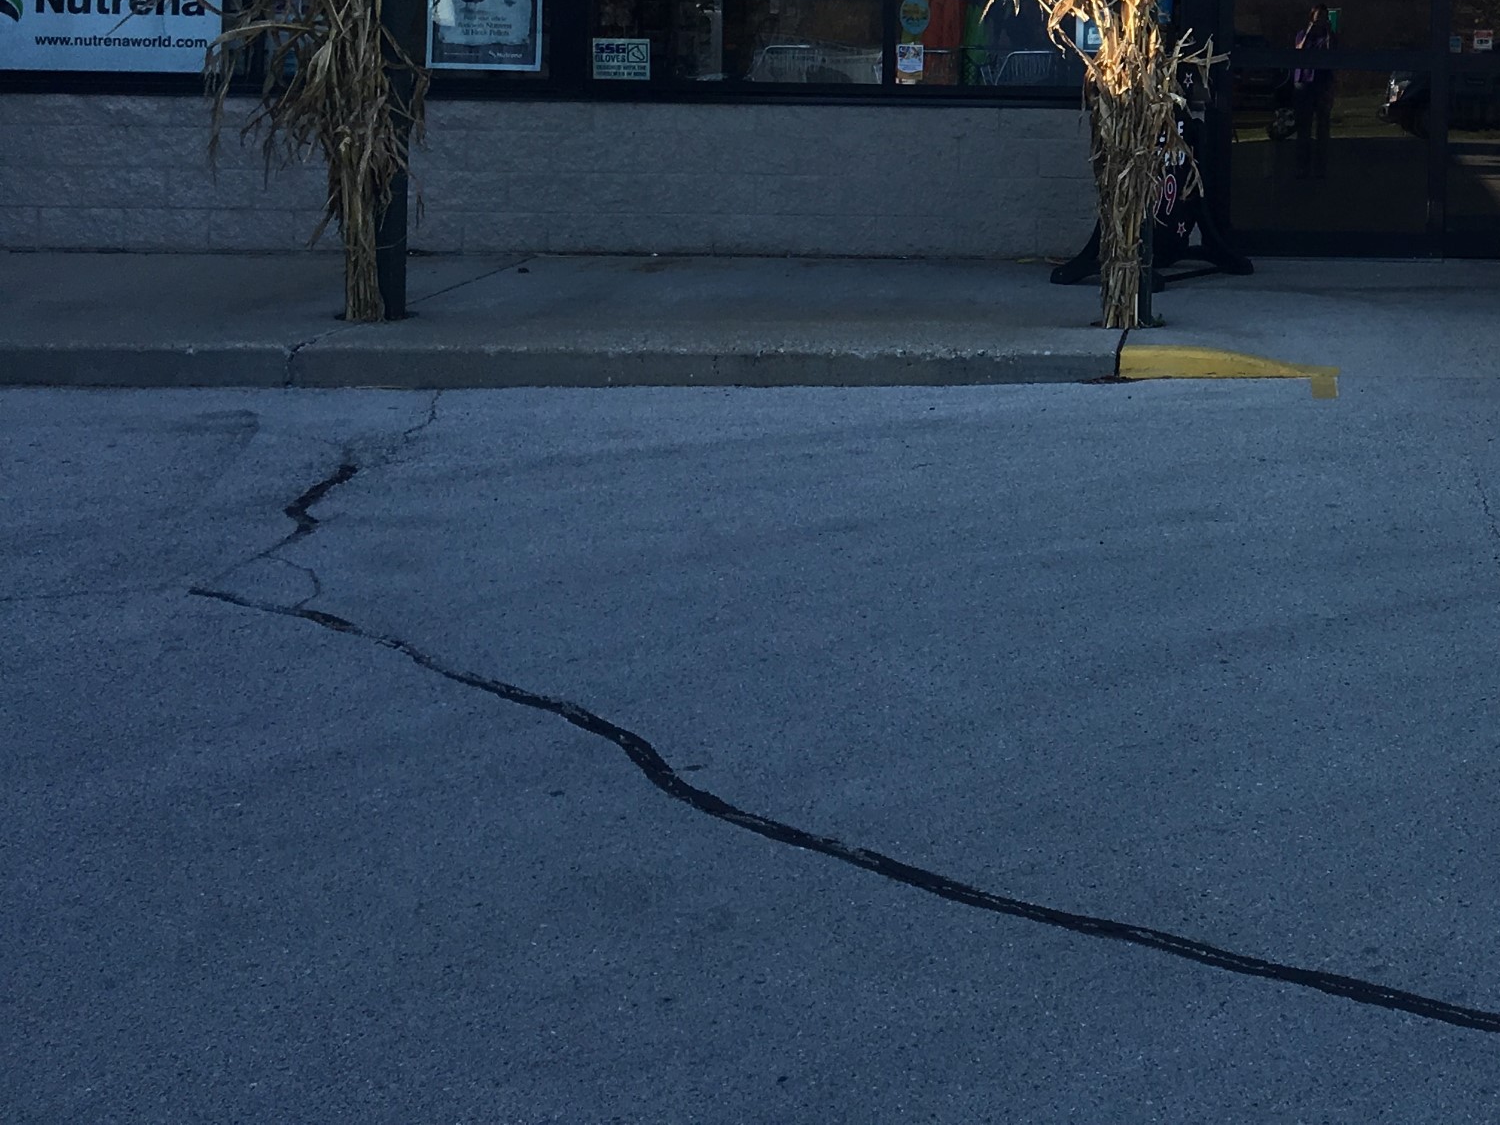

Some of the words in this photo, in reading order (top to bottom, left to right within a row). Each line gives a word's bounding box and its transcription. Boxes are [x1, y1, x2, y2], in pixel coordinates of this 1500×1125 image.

[35, 34, 208, 49] www.nutrenaworld.com
[595, 43, 627, 55] SSG
[595, 54, 627, 64] GLOVES
